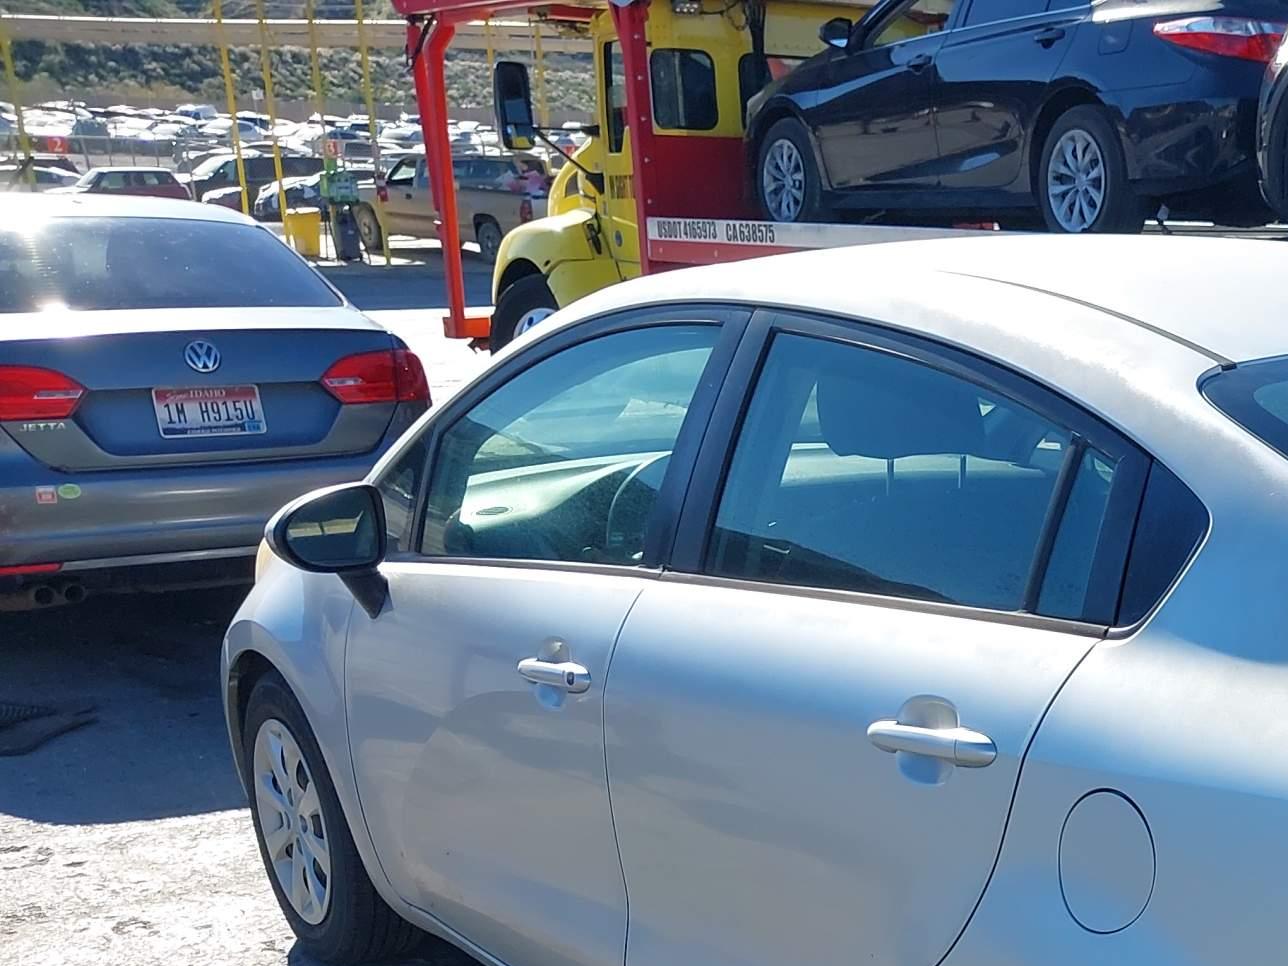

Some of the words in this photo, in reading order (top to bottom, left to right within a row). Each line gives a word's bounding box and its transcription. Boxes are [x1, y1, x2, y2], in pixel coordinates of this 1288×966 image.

[53, 137, 63, 152] 2
[189, 388, 226, 399] IDAHO
[20, 422, 67, 432] JETTA
